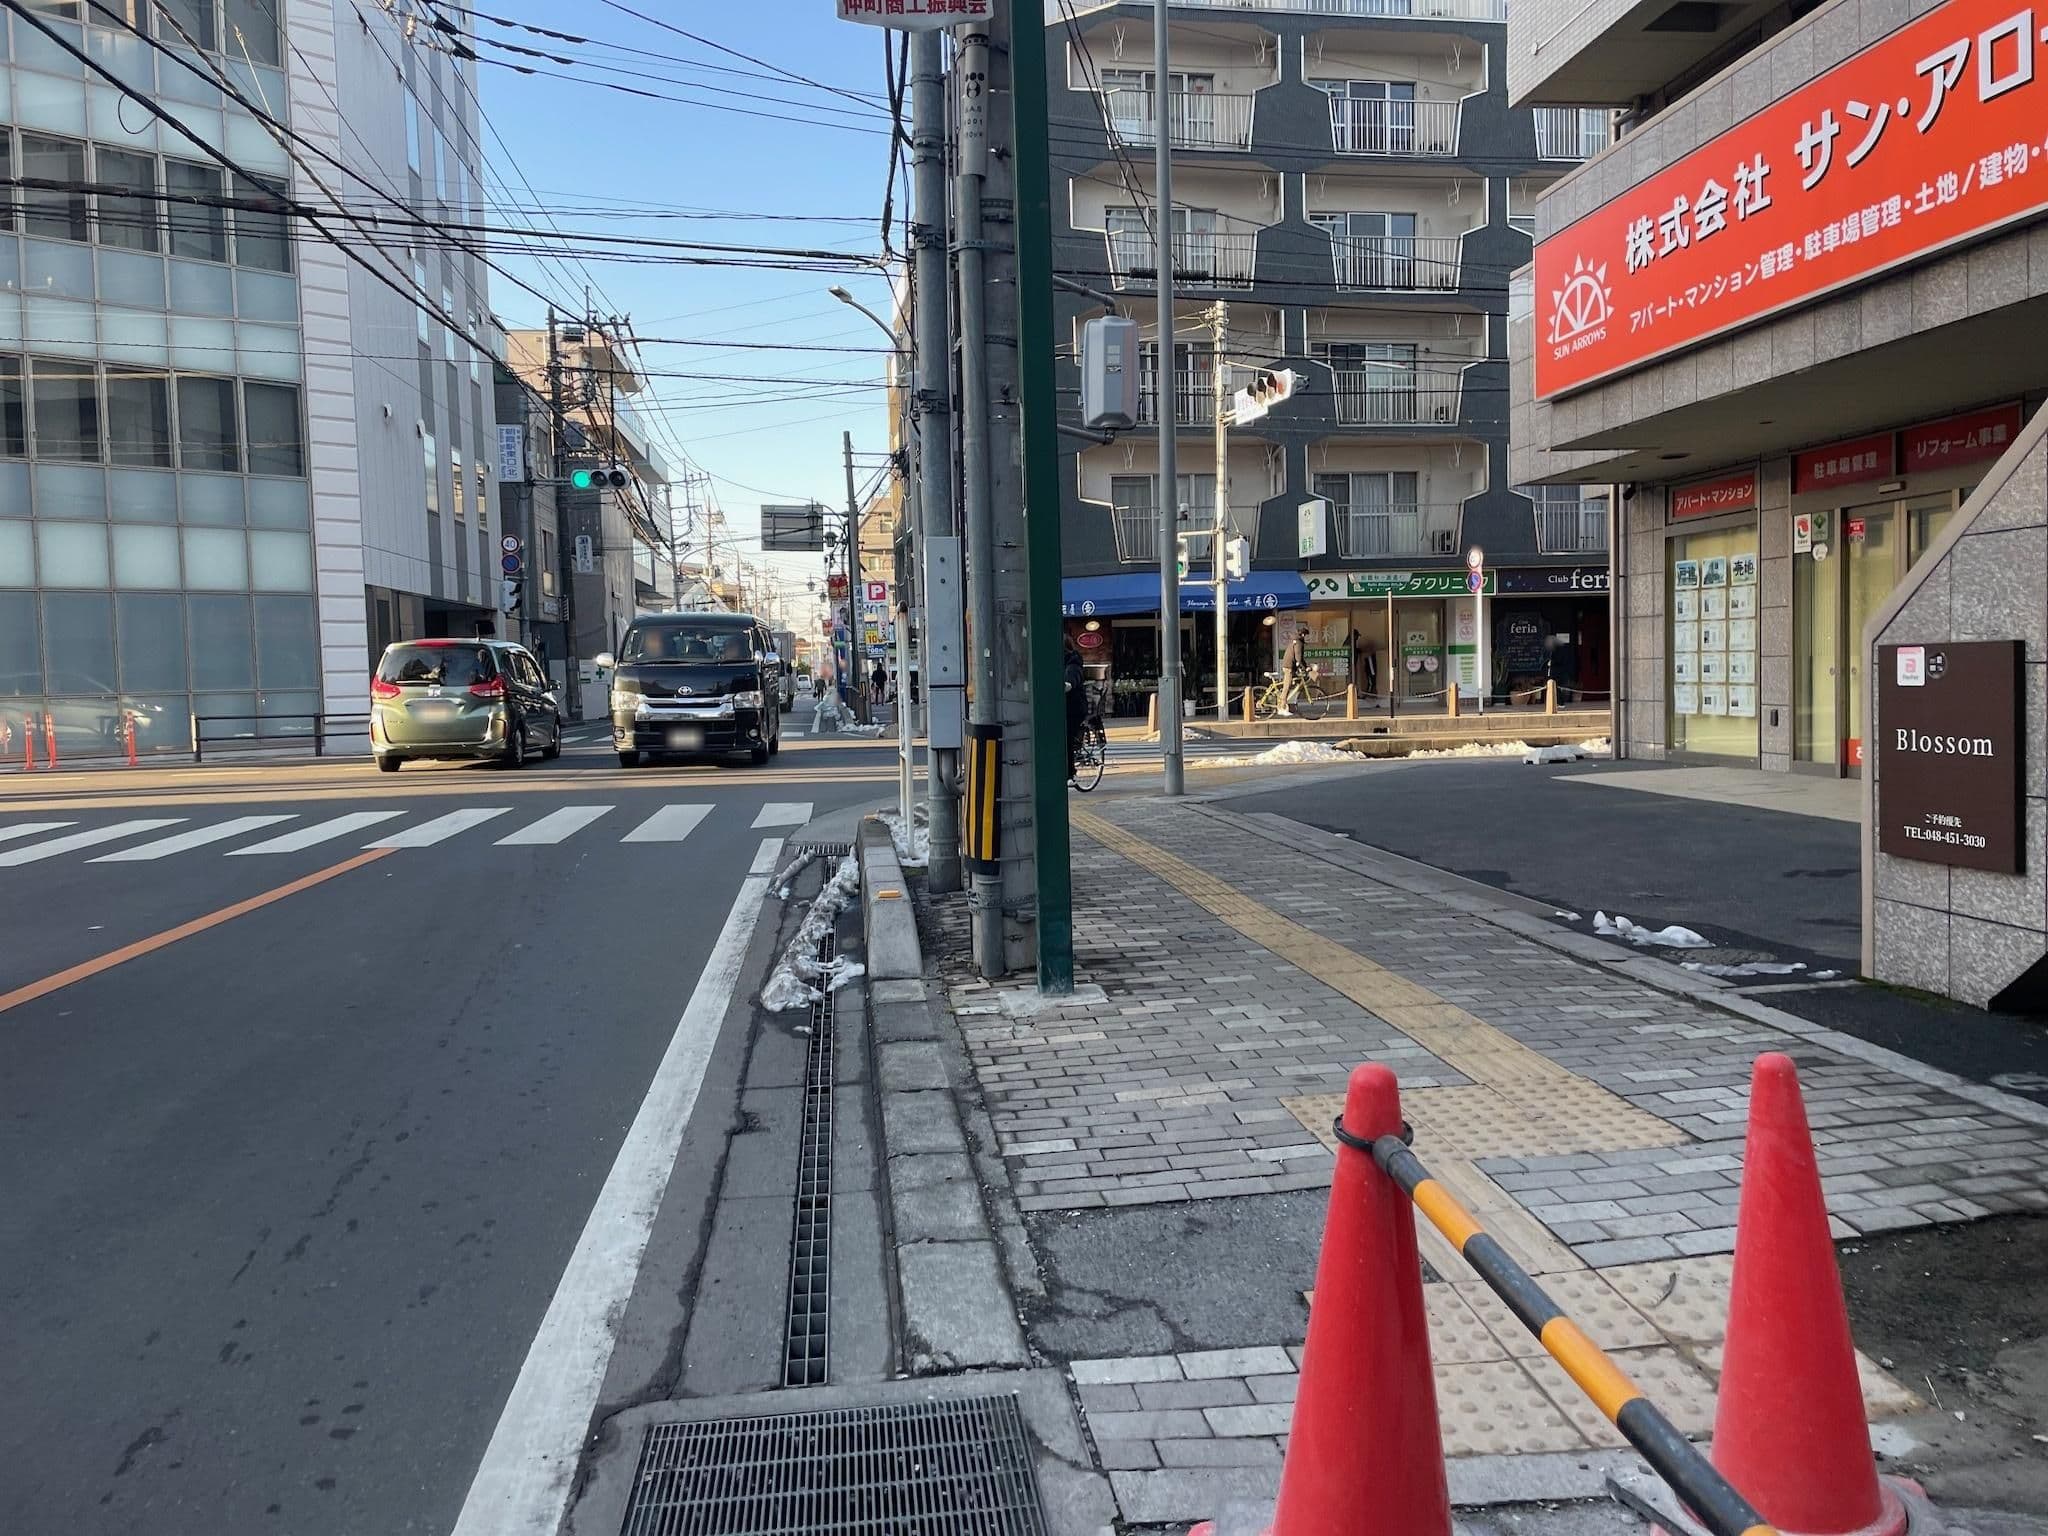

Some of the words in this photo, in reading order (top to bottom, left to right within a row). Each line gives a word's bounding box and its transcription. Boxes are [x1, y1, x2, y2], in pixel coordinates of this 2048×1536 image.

[843, 0, 987, 15] 仲町商工振興会
[1624, 152, 1773, 275] 株式会社
[1794, 8, 2048, 191] サン・アロ
[1629, 134, 2048, 334] アパート・マンション管理・駐車場管理・土地/建物・
[1553, 343, 1571, 360] SUN
[1571, 327, 1607, 352] ARROWS
[1814, 452, 1878, 479] 駐車場管理
[1676, 484, 1753, 511] アパート・マンション
[505, 539, 515, 548] 40
[1733, 559, 1754, 576] 売地
[1548, 574, 1568, 583] Club
[1570, 569, 1610, 589] feri
[870, 584, 884, 599] P
[1511, 623, 1537, 633] feria
[1896, 728, 1994, 756] Blossom
[1904, 826, 1986, 848] TEL:048-451-3030
